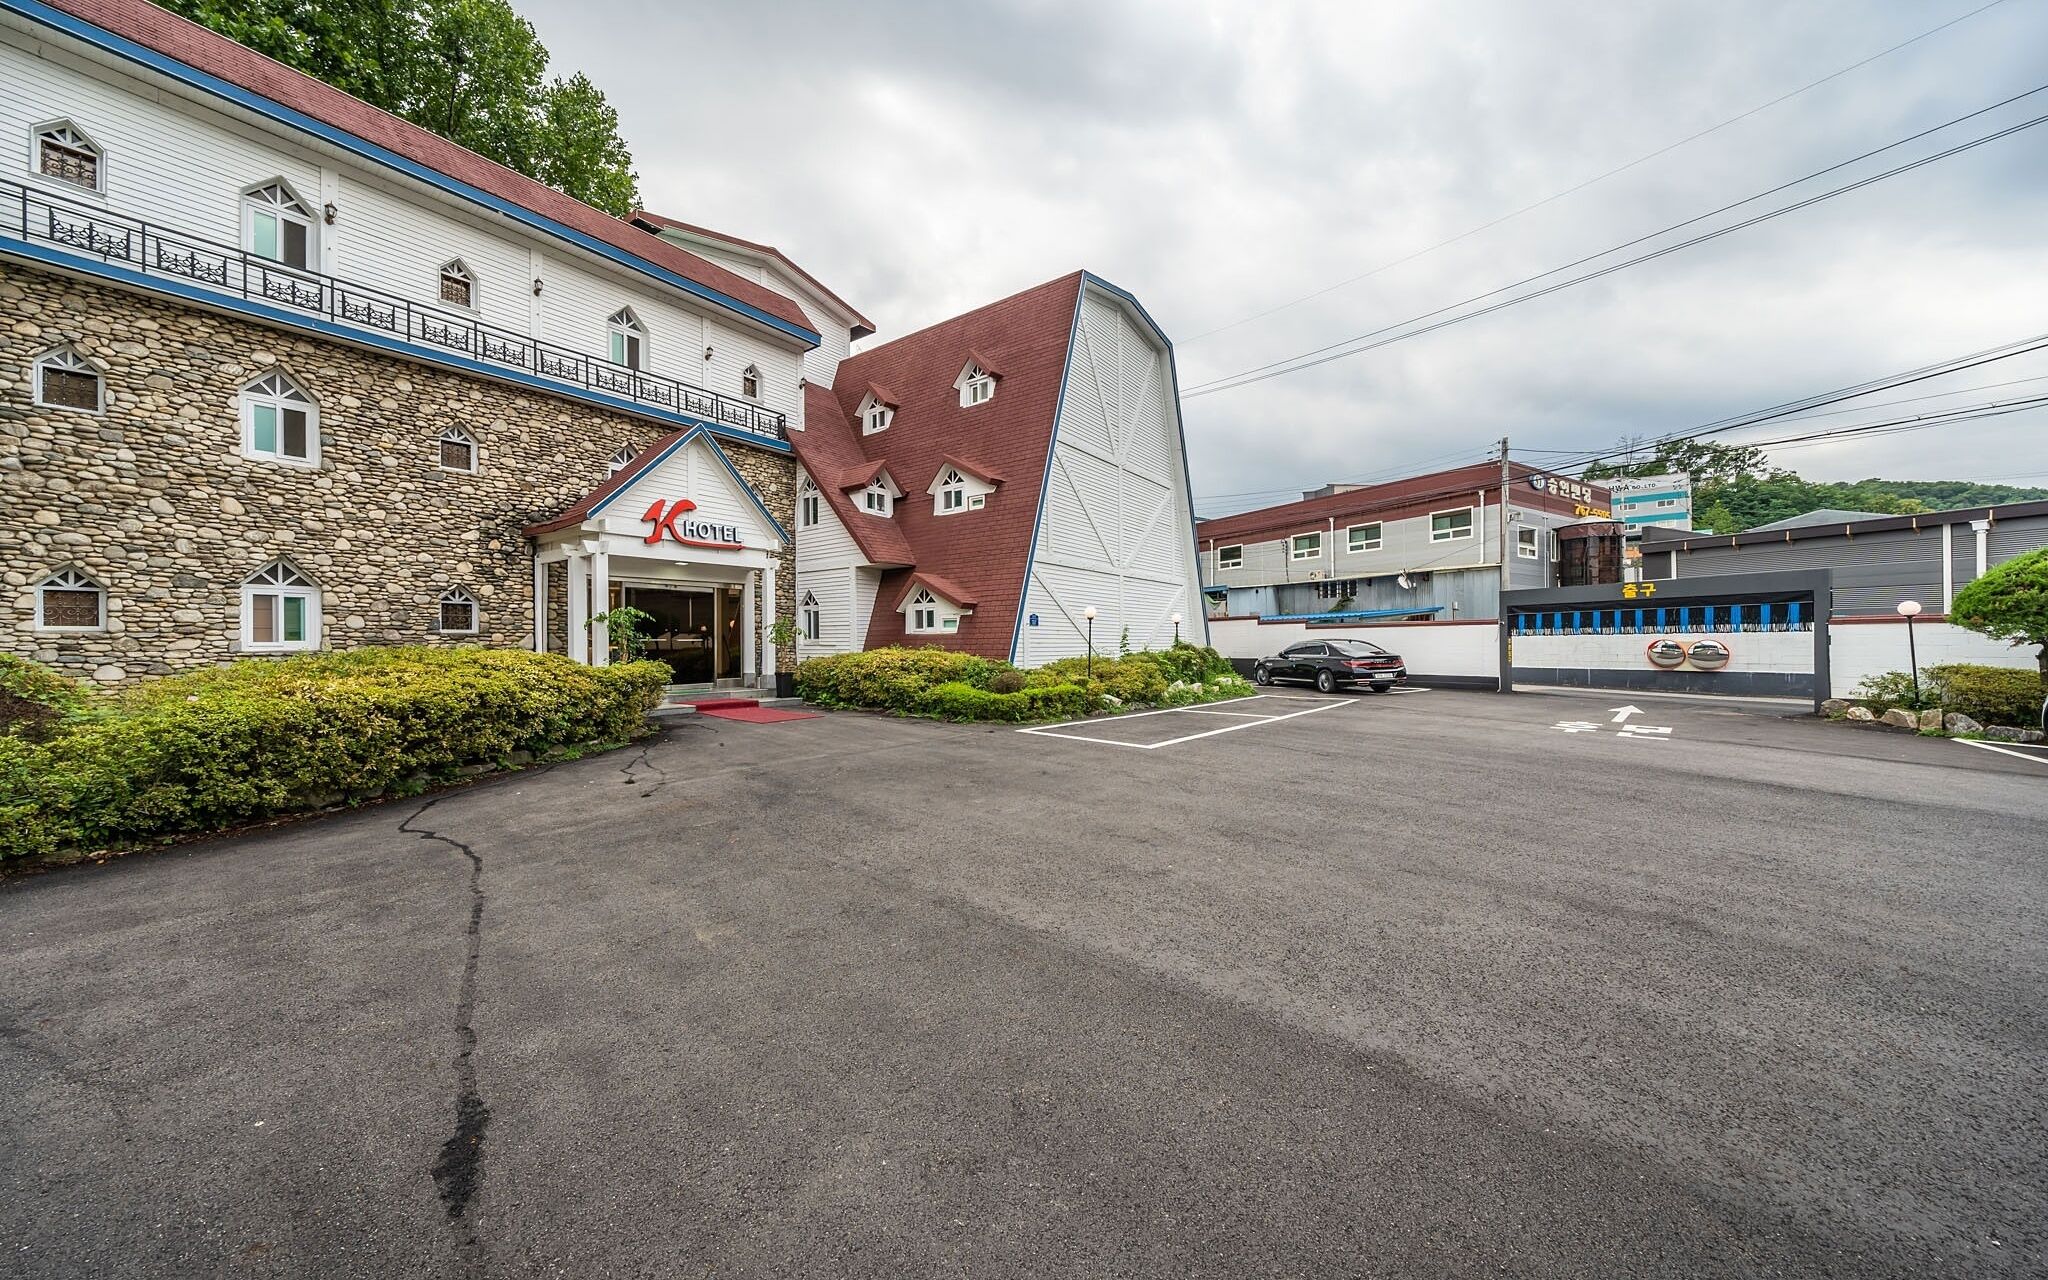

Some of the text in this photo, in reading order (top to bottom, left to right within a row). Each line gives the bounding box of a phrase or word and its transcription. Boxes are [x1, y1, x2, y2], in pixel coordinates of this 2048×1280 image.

[641, 499, 743, 548] K HOTEL
[1622, 583, 1657, 598] 출구
[1549, 721, 1673, 741] 후문
